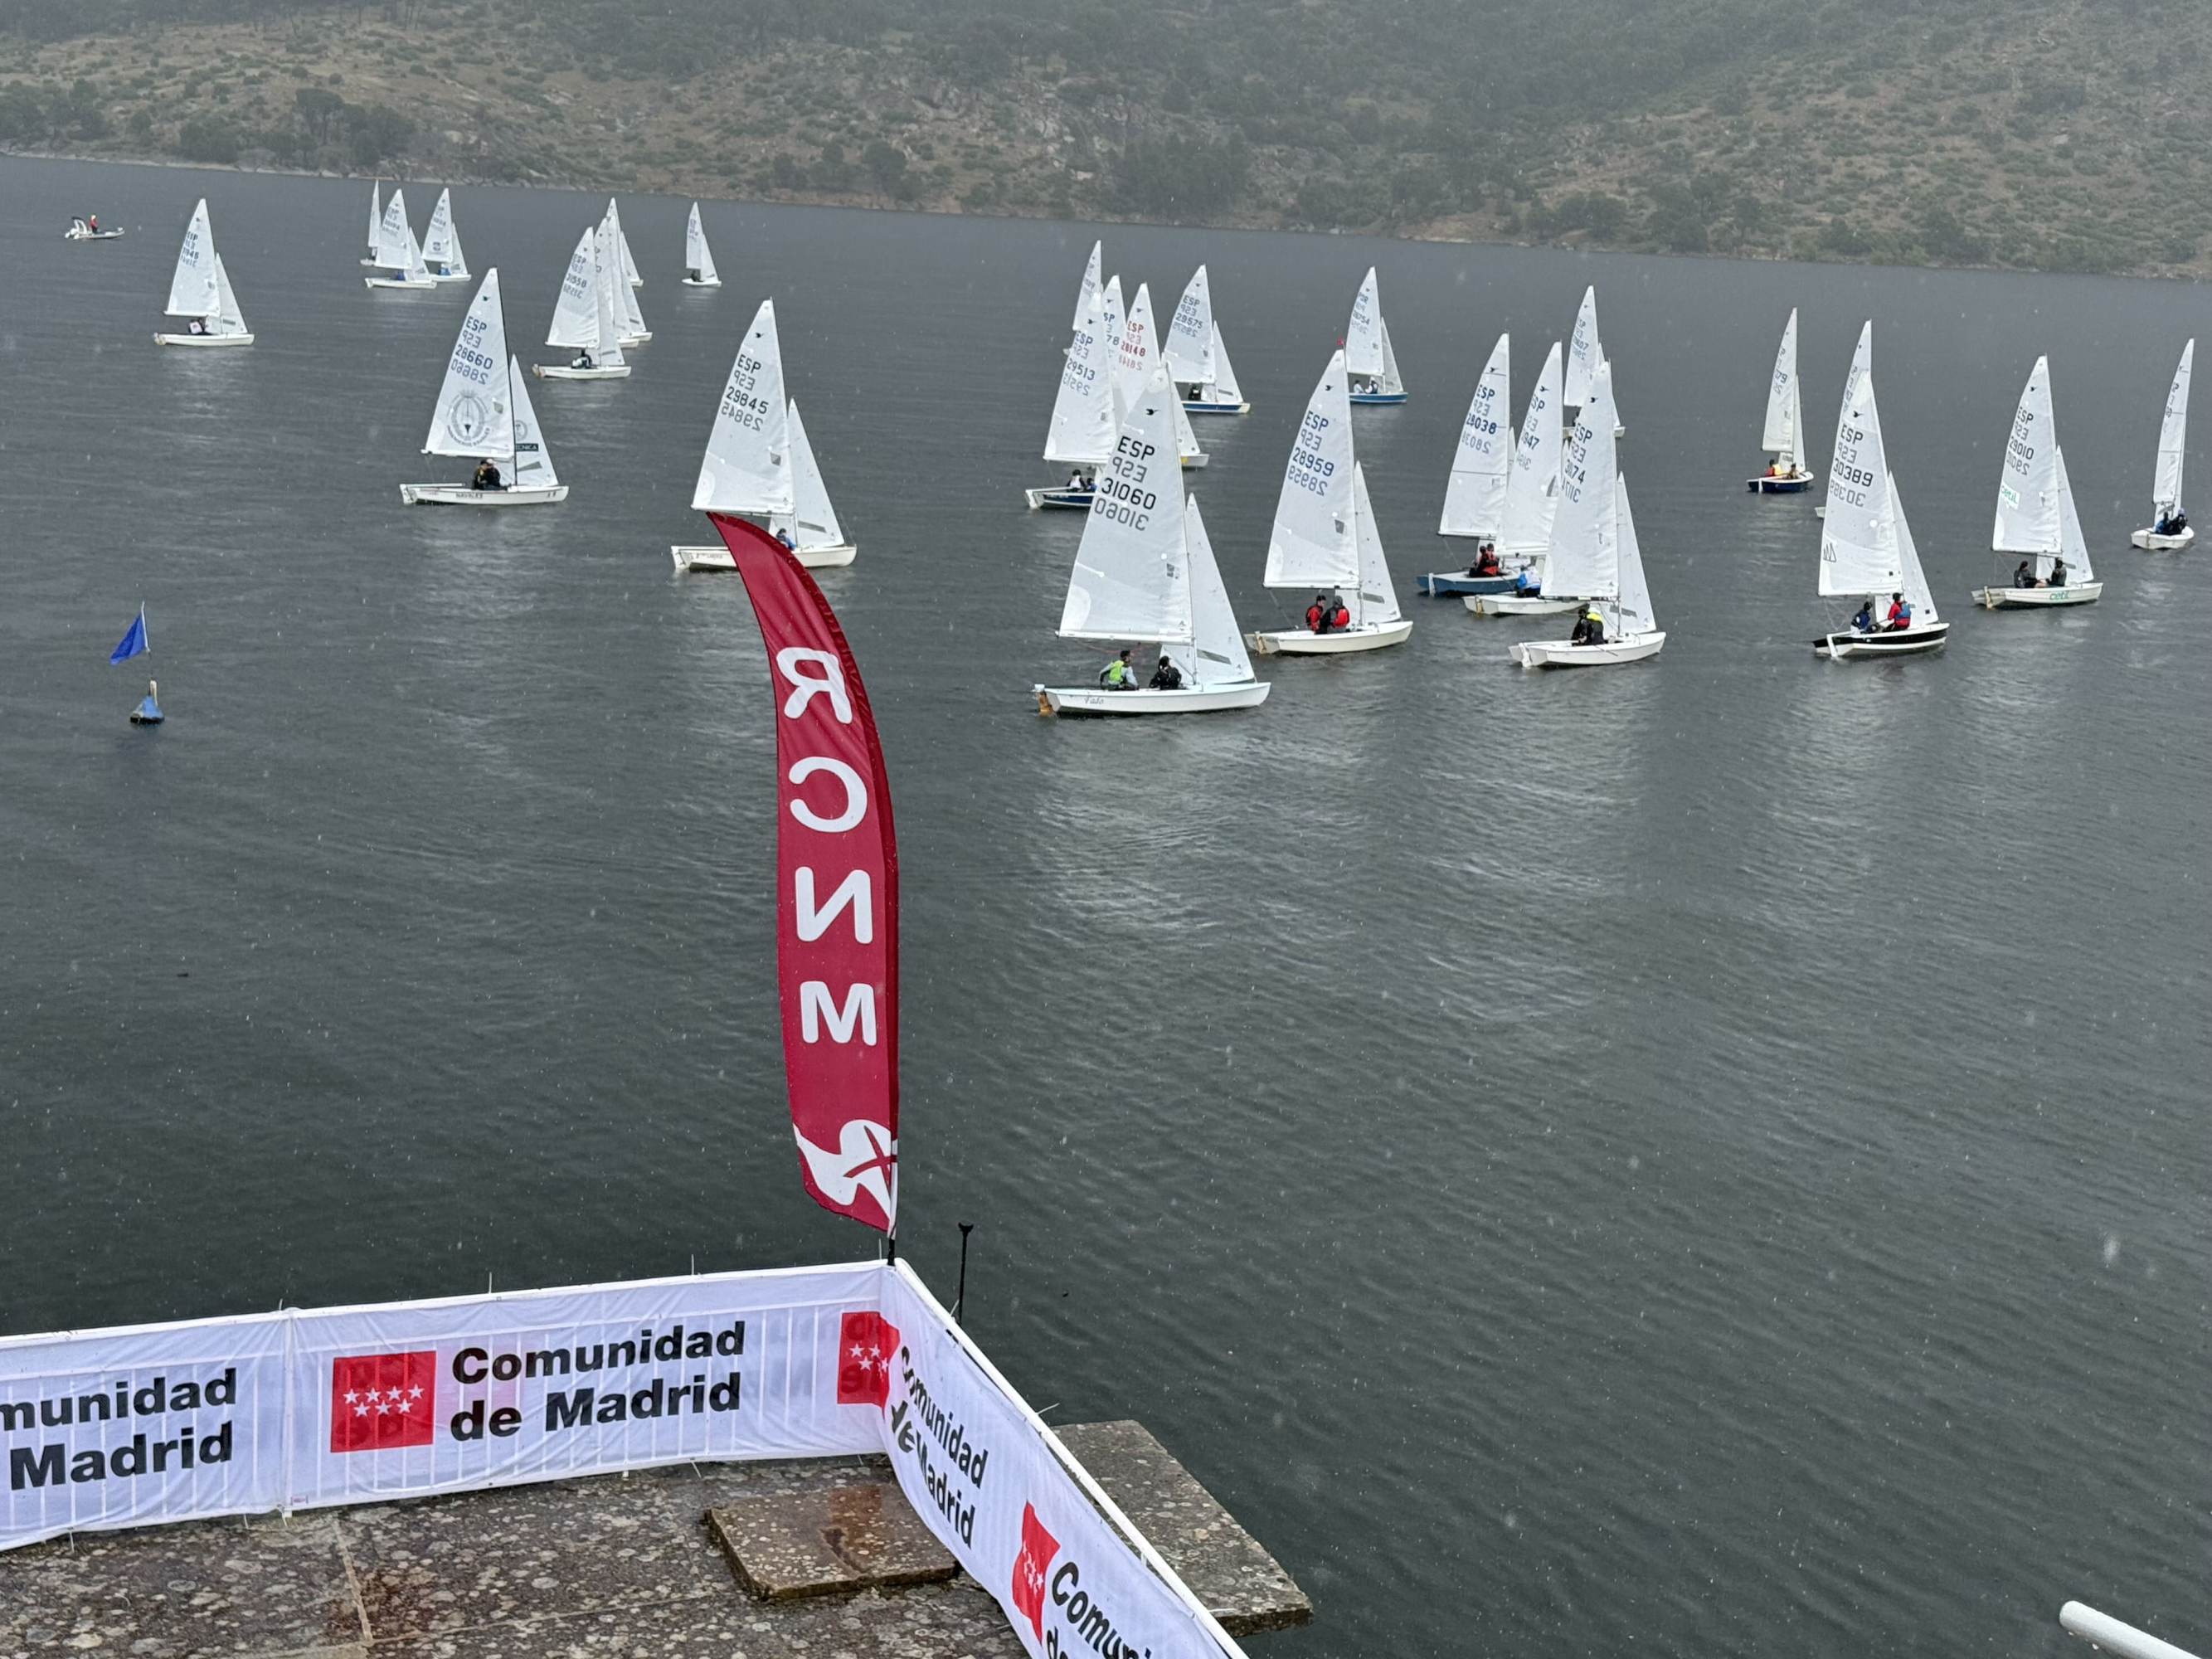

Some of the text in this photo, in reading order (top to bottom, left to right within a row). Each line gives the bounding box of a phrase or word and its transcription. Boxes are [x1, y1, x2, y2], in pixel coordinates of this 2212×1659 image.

[573, 253, 586, 265] ESP
[1183, 294, 1200, 307] ESP
[466, 315, 487, 333] ESP
[1103, 312, 1116, 323] SP
[1175, 313, 1203, 329] 29575
[1076, 330, 1093, 347] ESP
[455, 343, 493, 370] 28660
[737, 353, 761, 374] ESP
[1067, 358, 1096, 381] 29513
[726, 386, 769, 414] 29845
[1476, 384, 1495, 401] ESP
[1305, 410, 1329, 432] ESP
[2017, 406, 2034, 425] ESP
[1574, 422, 1592, 444] ESP
[1840, 423, 1864, 445] ESP
[1117, 435, 1155, 460] ESP
[2009, 435, 2034, 460] 29010
[1292, 447, 1334, 477] 28959
[1833, 457, 1874, 488] 30389
[1101, 477, 1157, 510] 31060
[452, 1321, 746, 1384] Comunidad
[450, 1371, 741, 1441] de Madrid
[902, 1345, 989, 1490] Comunidad
[10, 1420, 233, 1491] Madrid
[916, 1430, 975, 1550] Madrid
